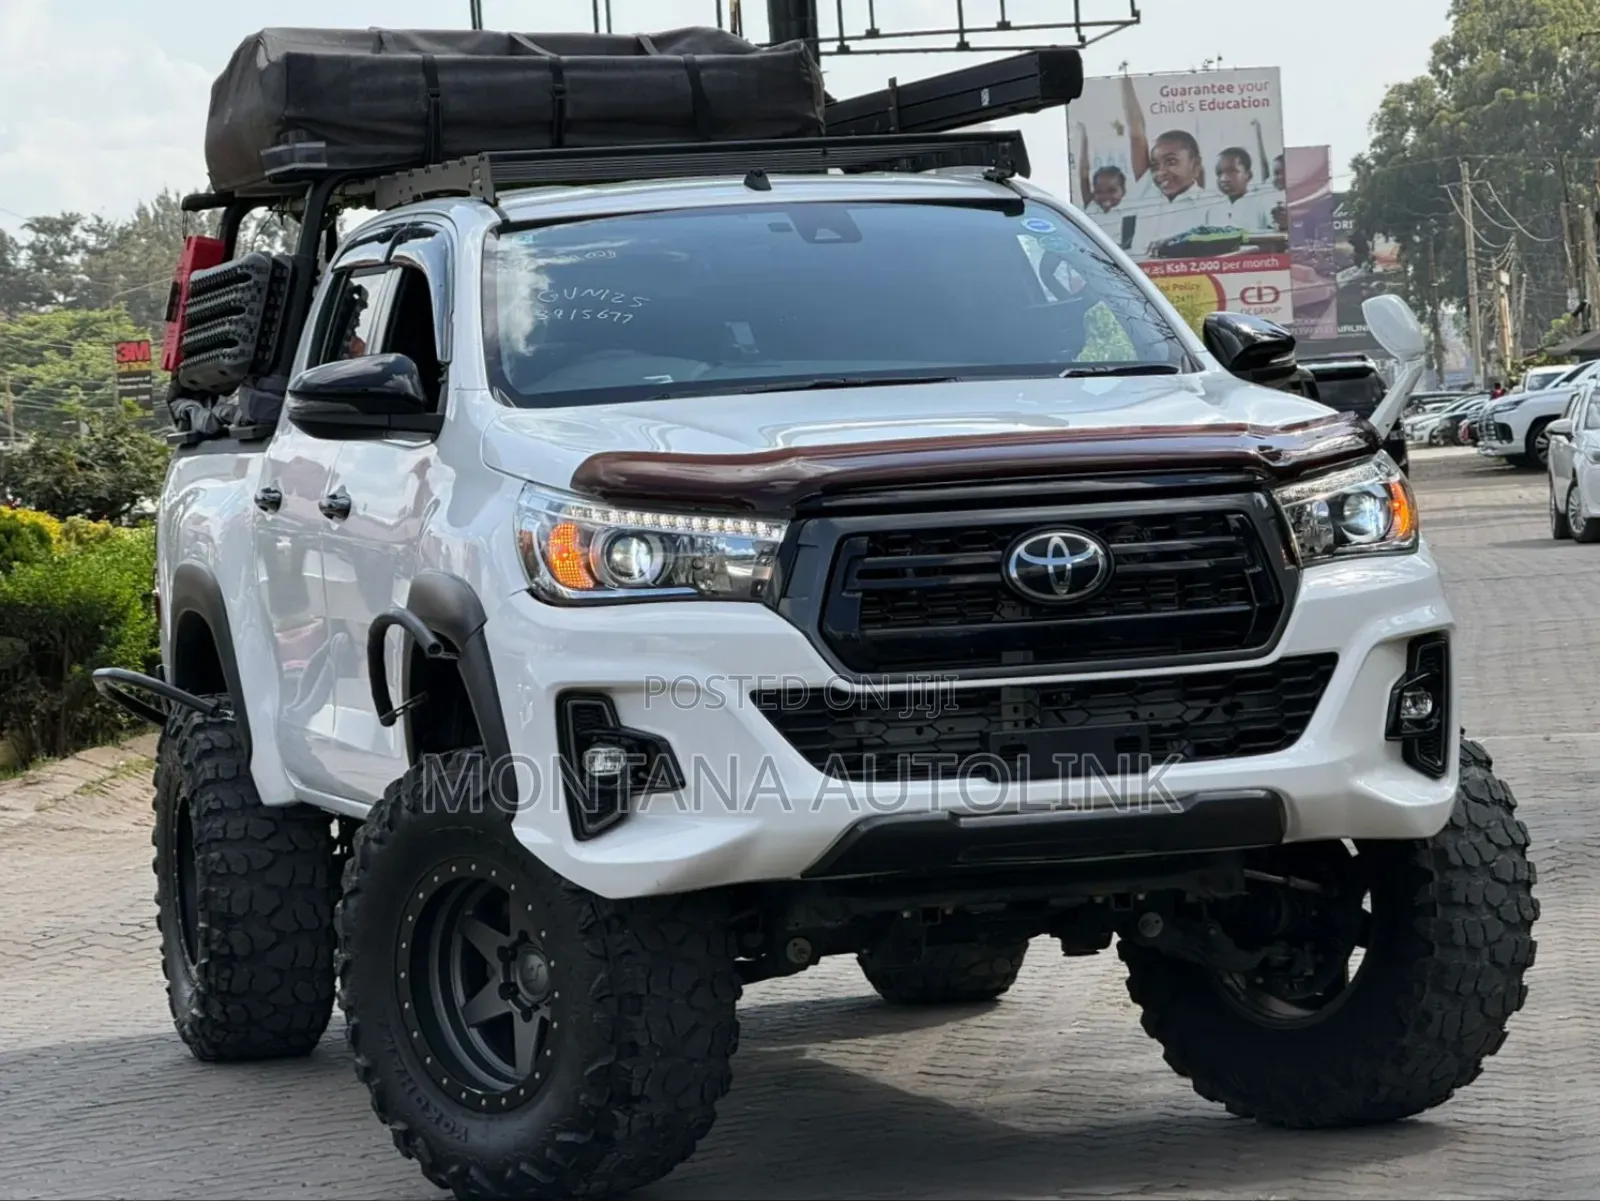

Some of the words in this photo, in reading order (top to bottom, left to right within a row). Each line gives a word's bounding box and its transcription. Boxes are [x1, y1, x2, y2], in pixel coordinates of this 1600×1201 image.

[1160, 83, 1235, 98] Guarantee
[1238, 81, 1270, 95] your
[1149, 100, 1195, 115] Child's
[1199, 96, 1270, 112] Education
[1166, 262, 1188, 273] Ksh
[1190, 260, 1220, 273] 2,000
[1222, 261, 1241, 271] per
[1242, 256, 1279, 269] month
[115, 340, 152, 362] 3M
